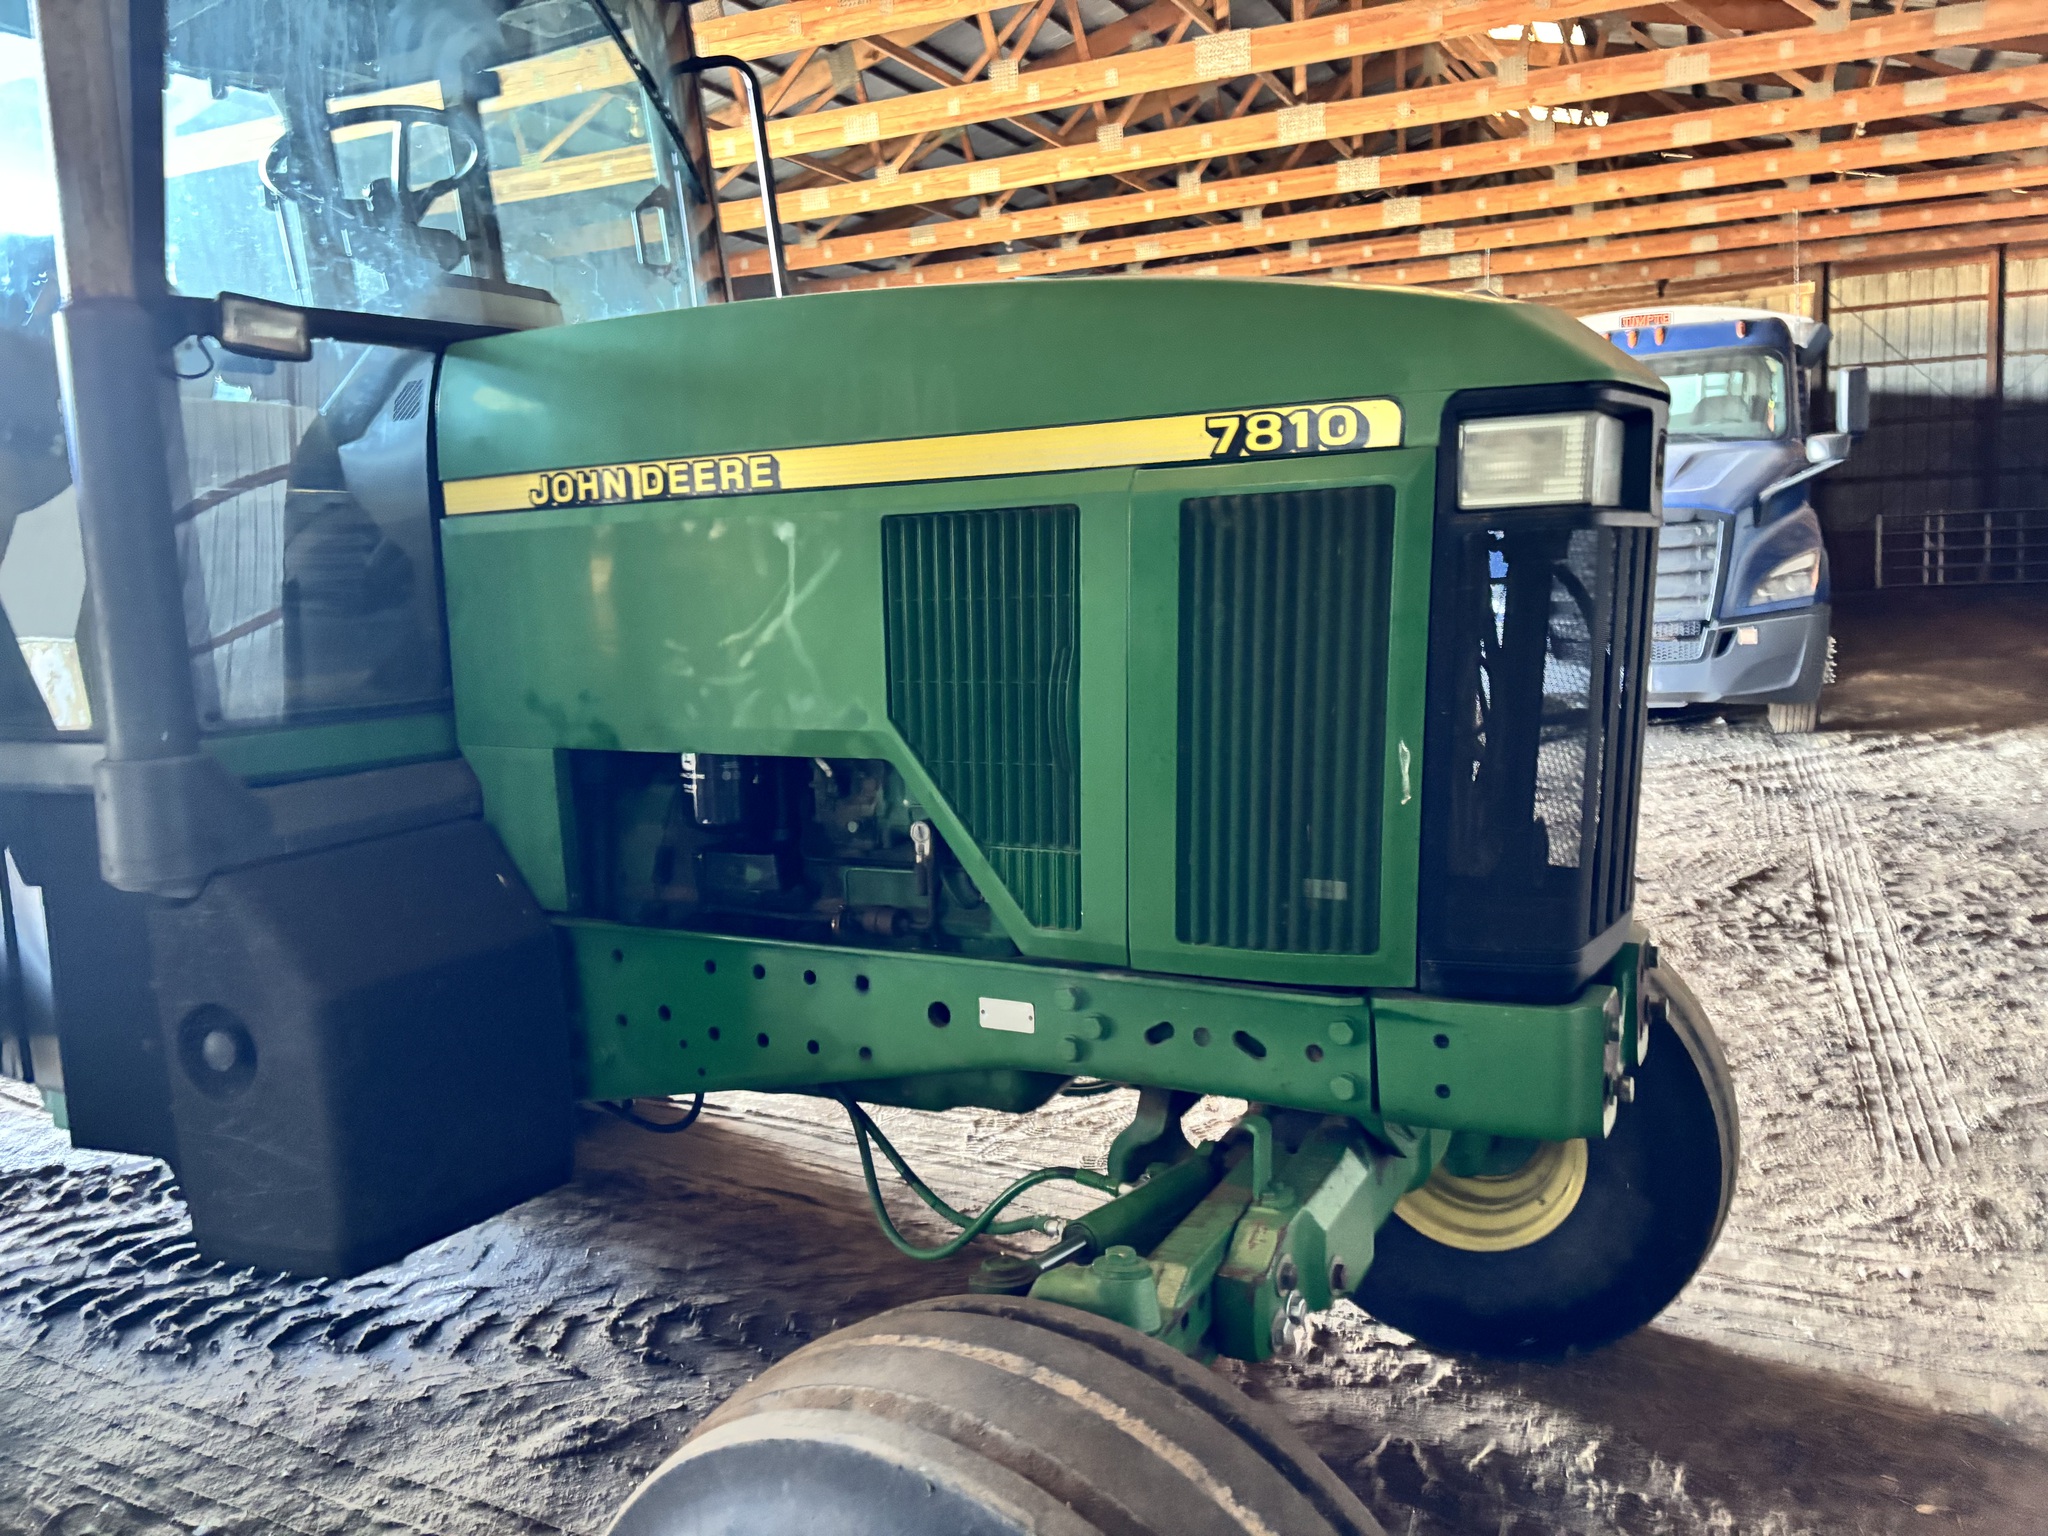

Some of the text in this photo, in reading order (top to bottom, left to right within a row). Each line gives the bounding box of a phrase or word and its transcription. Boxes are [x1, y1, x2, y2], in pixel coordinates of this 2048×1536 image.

[1205, 405, 1370, 457] 7810
[529, 454, 781, 508] JOHN DEERE
